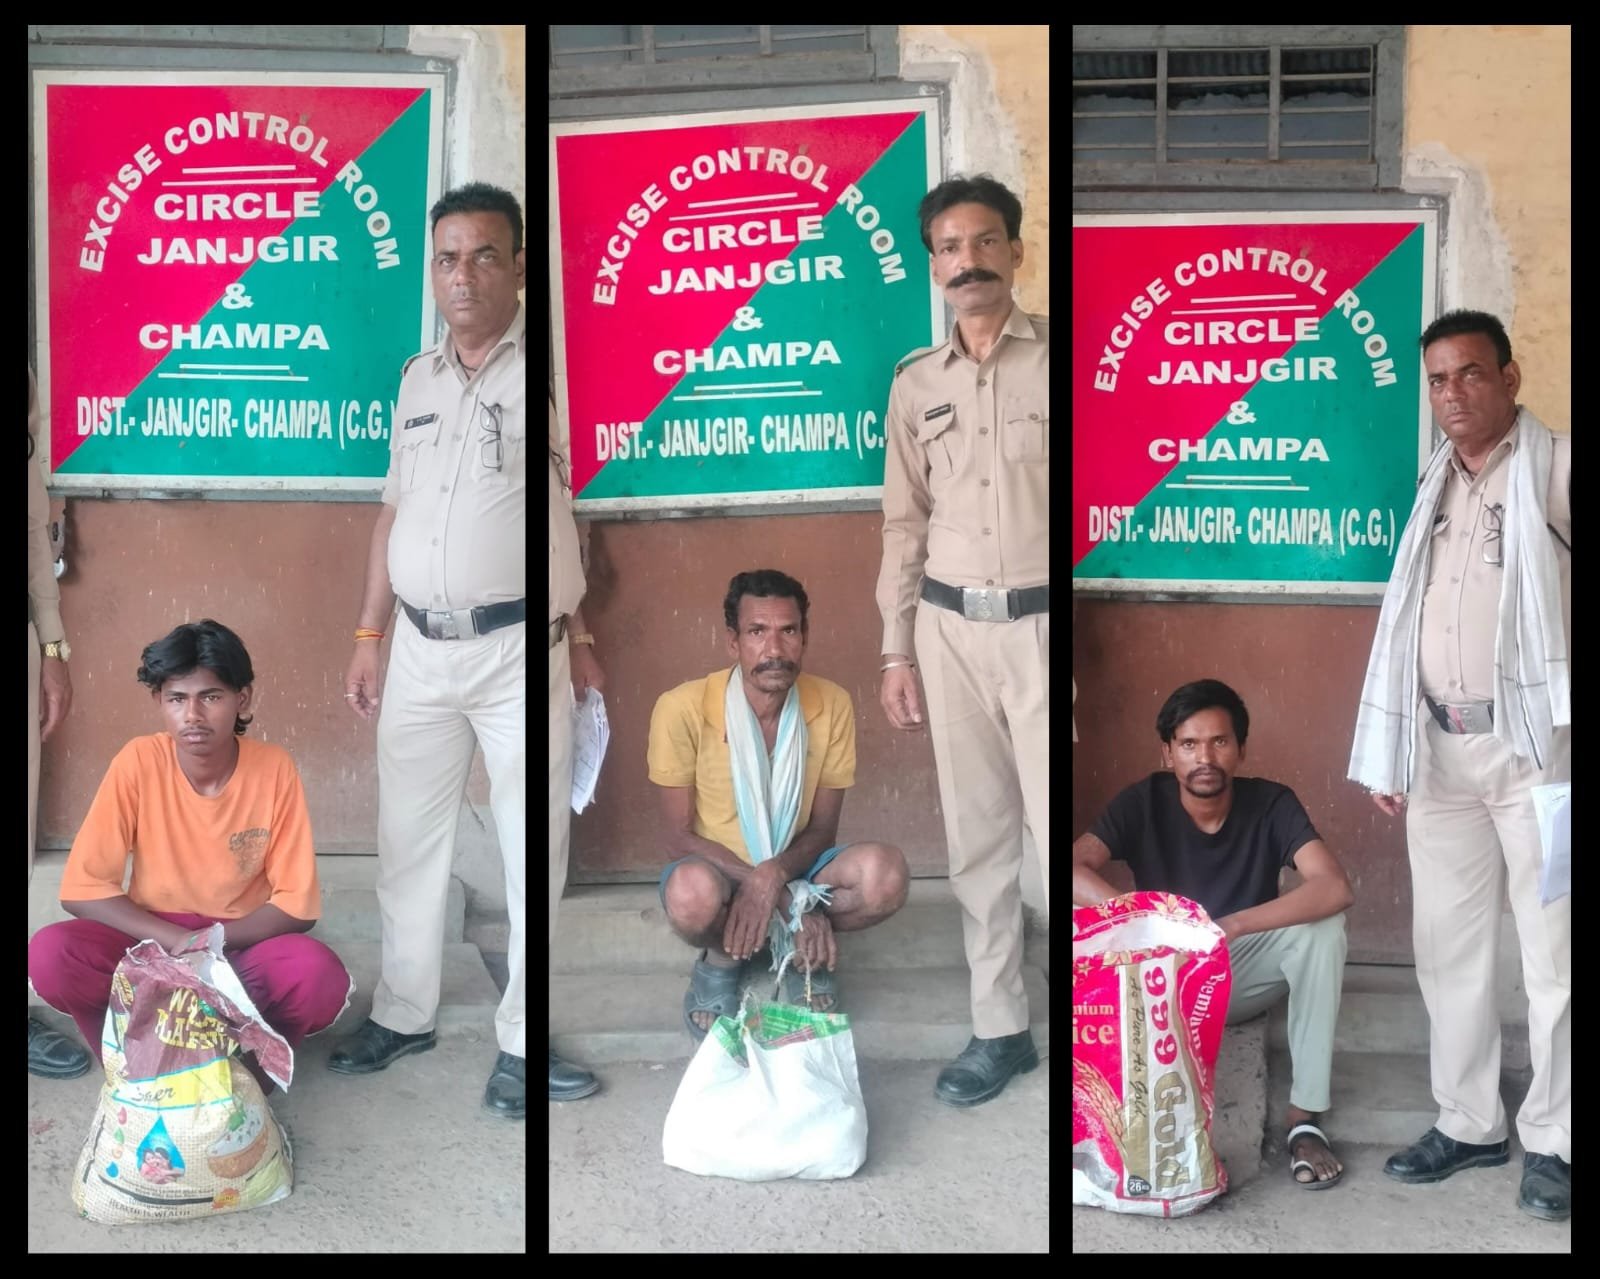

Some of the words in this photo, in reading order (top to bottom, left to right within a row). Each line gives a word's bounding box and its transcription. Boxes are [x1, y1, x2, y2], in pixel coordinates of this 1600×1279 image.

[79, 144, 162, 272] EXCISE
[164, 111, 329, 167] CONTROL
[335, 159, 400, 269] ROOM
[154, 191, 321, 221] CIRCLE
[593, 183, 668, 305] EXCISE
[669, 146, 828, 192] CONTROL
[836, 183, 906, 284] ROOM
[662, 215, 824, 253] CIRCLE
[137, 235, 338, 265] JANJGIR
[648, 255, 844, 295] JANJGIR
[221, 282, 253, 309] &
[731, 305, 763, 331] &
[1094, 278, 1171, 392] EXCISE
[1174, 247, 1327, 295] CONTROL
[1334, 289, 1396, 387] ROOM
[1164, 317, 1320, 345] CIRCLE
[139, 323, 329, 350] CHAMPA
[653, 340, 842, 375] CHAMPA
[1148, 357, 1337, 385] JANJGIR
[141, 398, 238, 437] JANJGIR-
[244, 399, 332, 438] CHAMPA
[339, 399, 395, 450] (C.G.)
[1226, 400, 1256, 425] &
[659, 417, 755, 458] JANJGIR-
[760, 412, 850, 454] CHAMPA
[855, 410, 889, 460] (C.
[1148, 438, 1329, 462] CHAMPA
[1149, 506, 1242, 543] JANJGIR-
[1248, 507, 1333, 545] CHAMPA
[1339, 509, 1396, 556] (C.G.)
[1143, 965, 1178, 1066] 999
[1153, 1071, 1190, 1193] Gold
